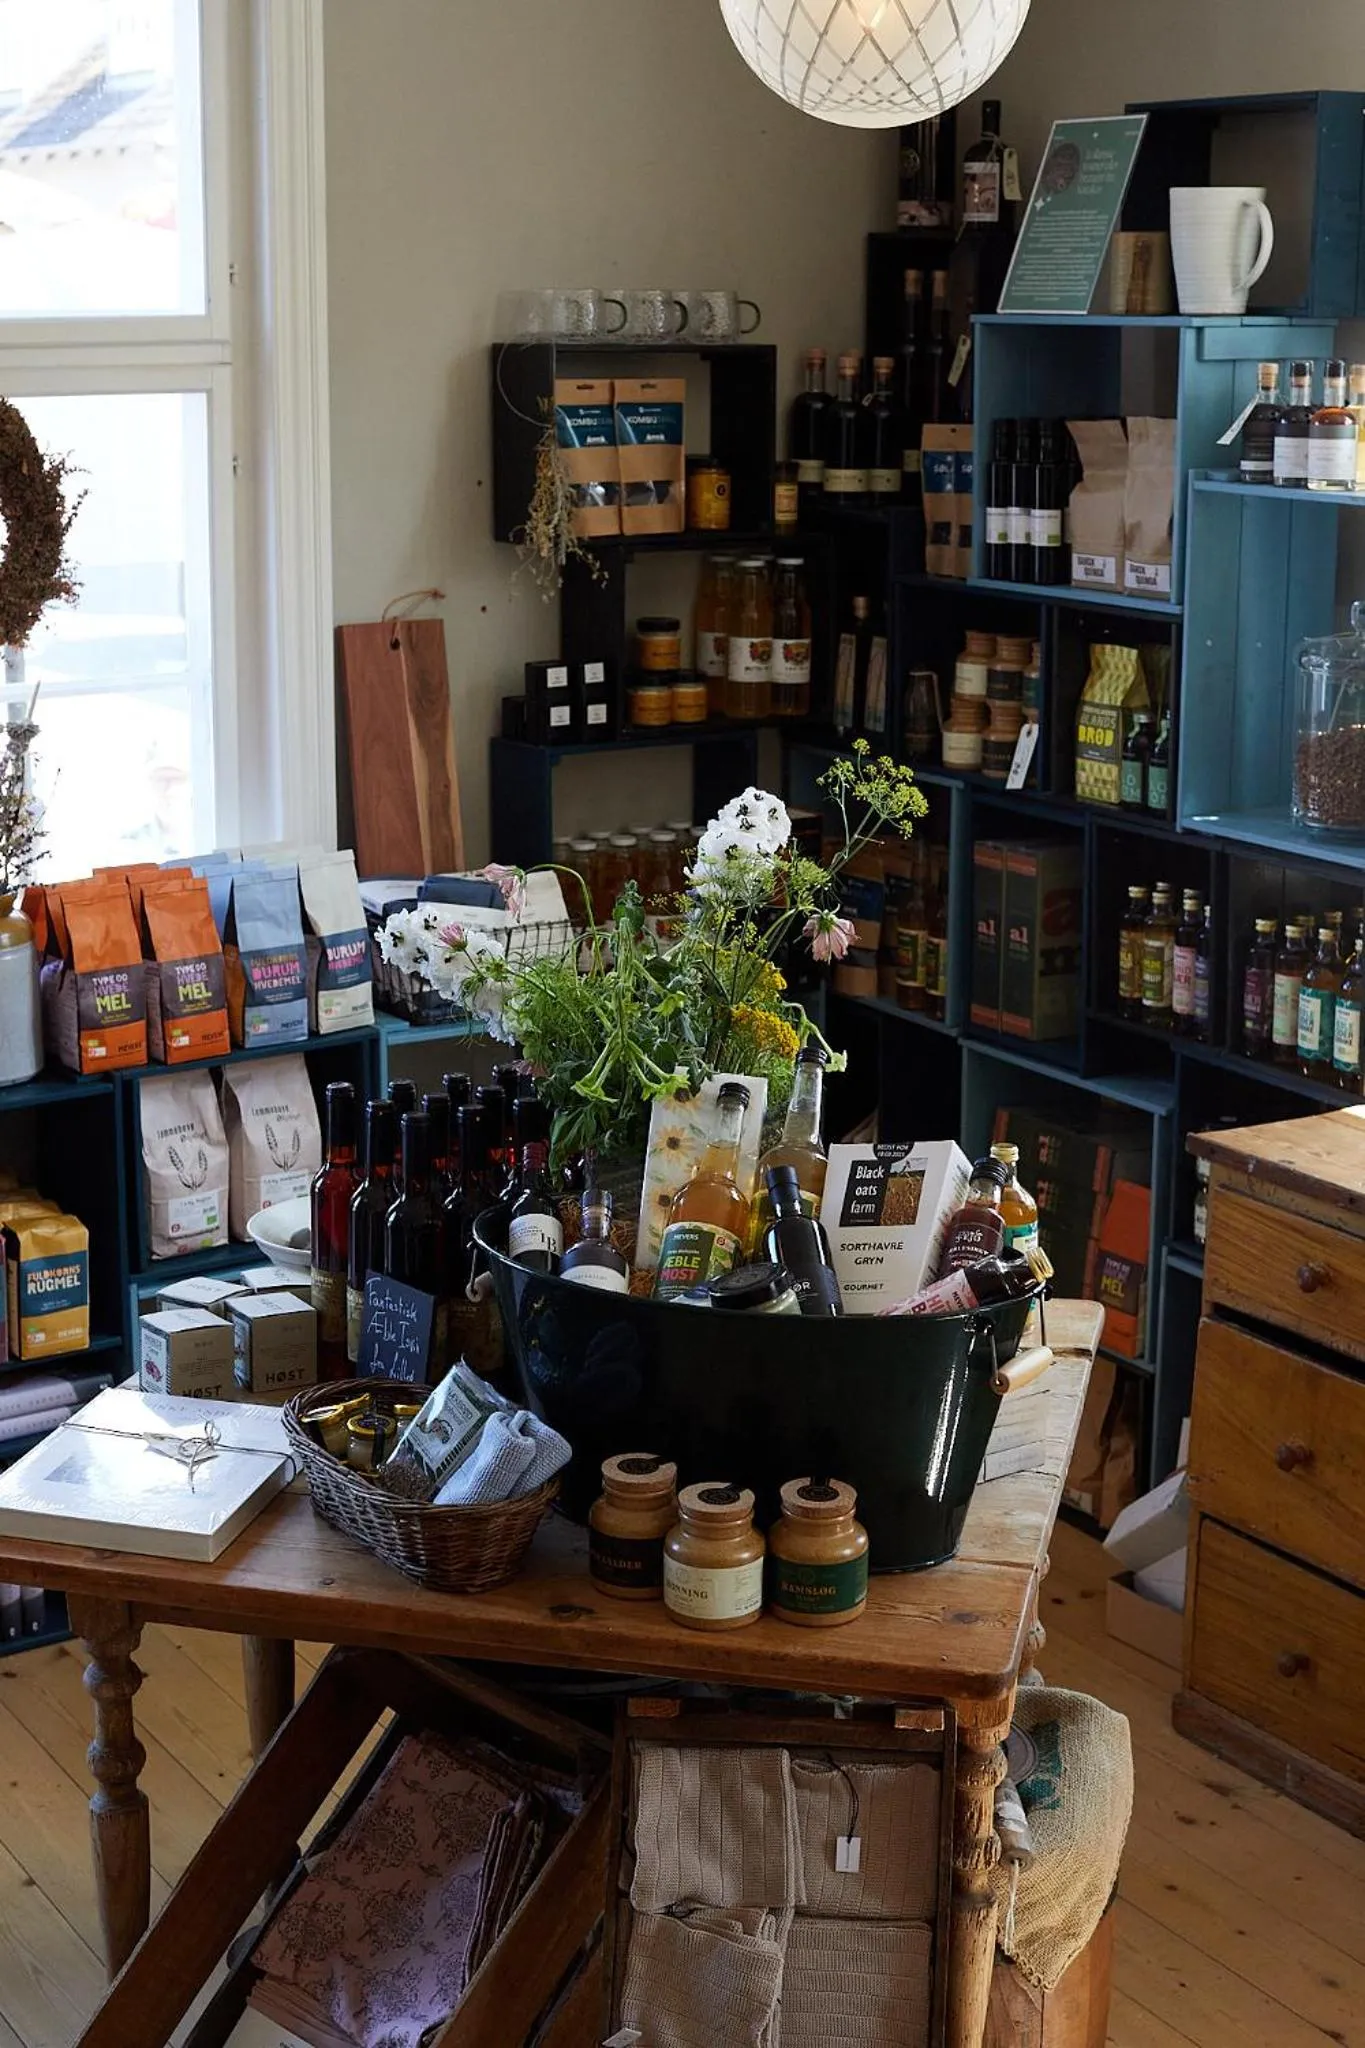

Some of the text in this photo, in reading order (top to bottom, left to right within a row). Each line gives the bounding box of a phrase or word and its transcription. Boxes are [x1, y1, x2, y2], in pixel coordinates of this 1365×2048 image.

[175, 963, 195, 975] TYPE
[92, 976, 115, 987] TYPE
[253, 975, 303, 991] HVEDEMEL
[178, 982, 212, 1002] MEL
[96, 993, 132, 1014] MEL
[855, 1164, 885, 1181] Black
[855, 1184, 879, 1197] oats
[850, 1200, 876, 1215] farm
[840, 1240, 905, 1253] SORTHAVRE
[662, 1254, 702, 1270] ÆBLE
[854, 1255, 885, 1267] GRYN
[27, 1264, 82, 1283] FULDKORNS
[27, 1273, 82, 1296] RUGMEL
[843, 1283, 885, 1292] GOURMET
[1100, 1274, 1125, 1298] MEL
[265, 1367, 306, 1385] HØST
[182, 1384, 223, 1399] HØST
